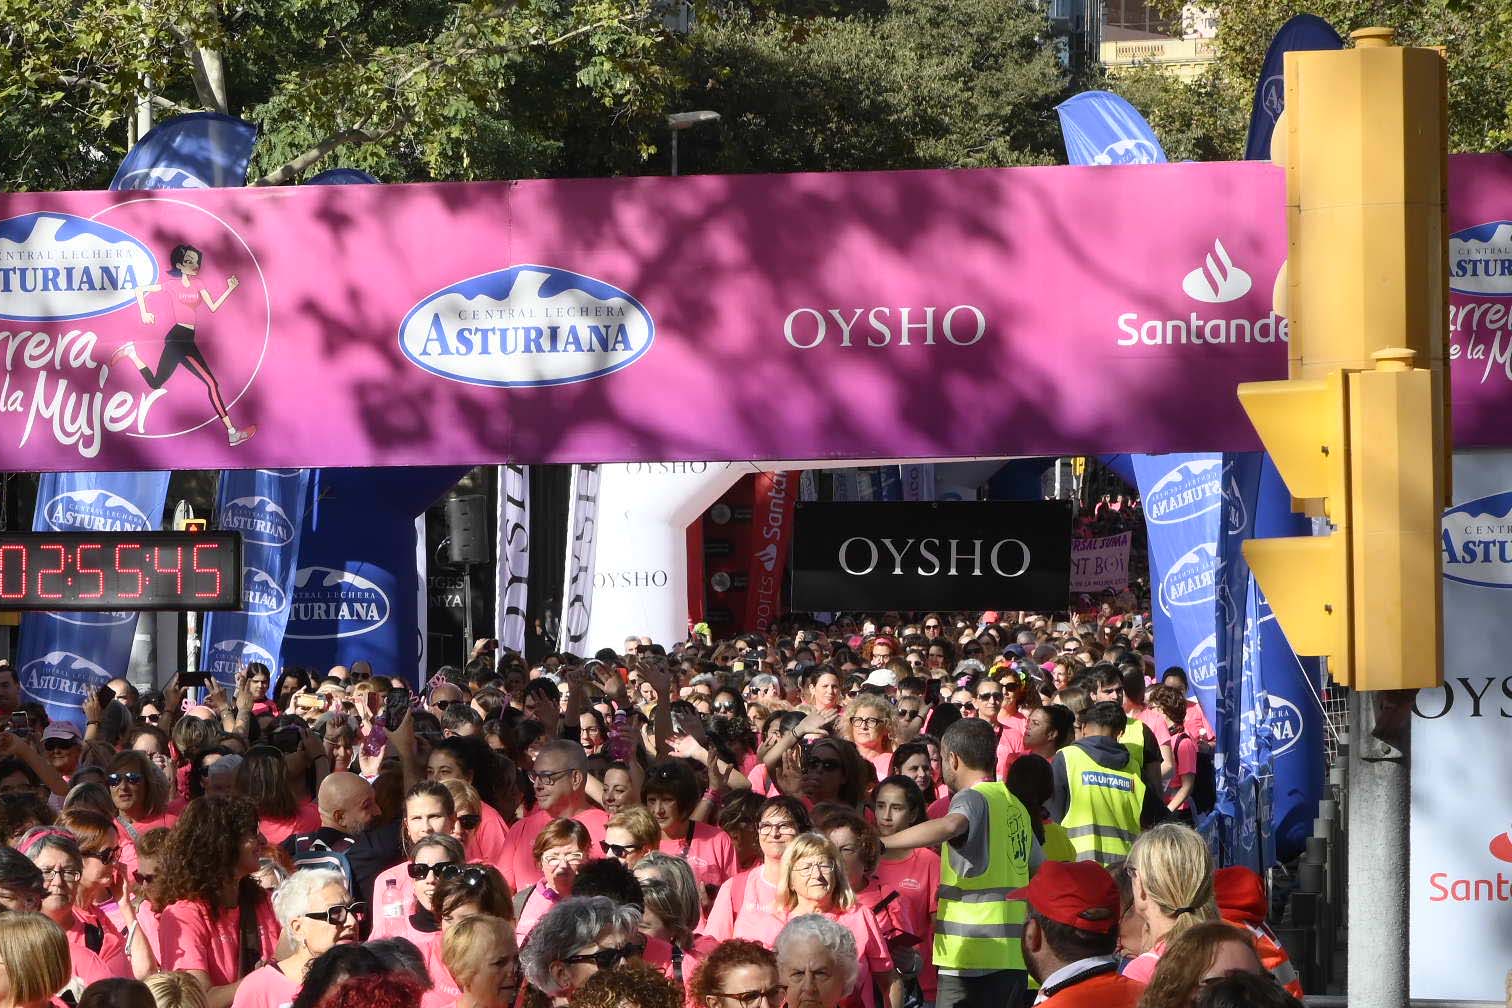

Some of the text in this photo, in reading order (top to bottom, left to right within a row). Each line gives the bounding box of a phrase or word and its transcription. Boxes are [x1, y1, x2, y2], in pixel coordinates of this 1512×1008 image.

[61, 248, 133, 260] LECHERA
[1449, 259, 1512, 277] STUR
[459, 305, 625, 320] CENTRAL LECHERA
[783, 304, 986, 349] OYSHO
[419, 312, 633, 357] ASTURIANA
[1117, 311, 1288, 346] Santande
[1450, 333, 1462, 360] e
[1467, 333, 1486, 360] la
[0, 374, 24, 413] la
[19, 368, 168, 458] Mujer
[838, 536, 1031, 578] OYSHO
[288, 602, 380, 621] TURIANA
